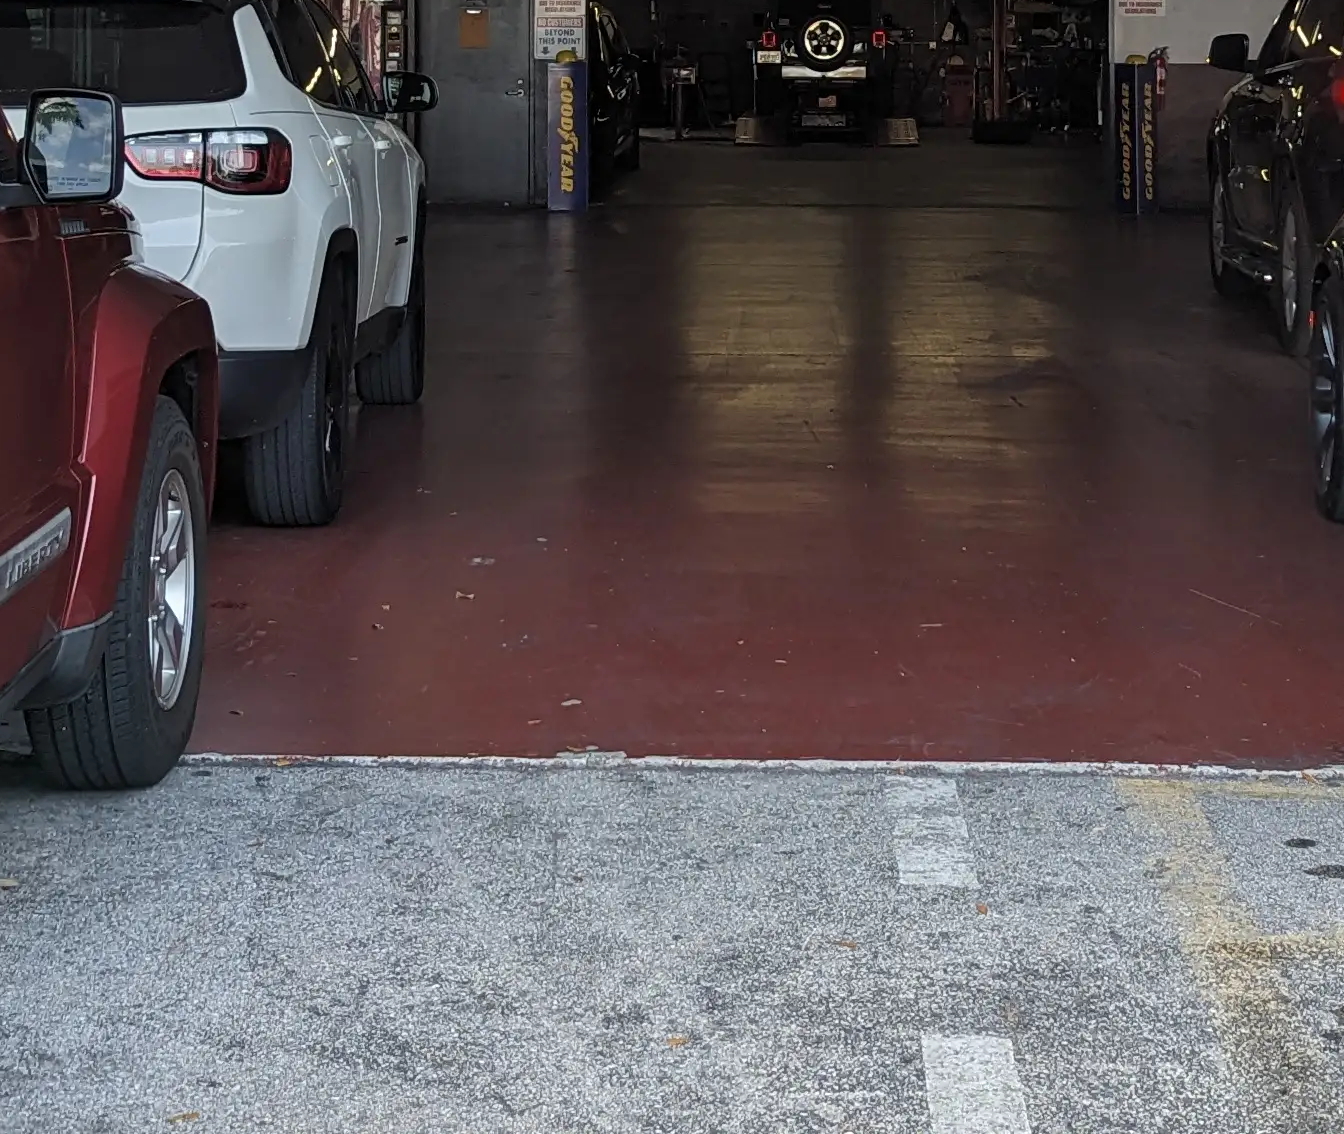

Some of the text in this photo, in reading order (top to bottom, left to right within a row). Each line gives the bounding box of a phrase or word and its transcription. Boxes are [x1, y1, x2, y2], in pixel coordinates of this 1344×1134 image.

[538, 18, 582, 26] NO CUSTOMERS
[539, 37, 581, 45] THIS POINT
[558, 76, 578, 194] GOODYEAR
[1120, 83, 1132, 200] GOODYEAR
[1142, 83, 1154, 200] GOODYEAR
[5, 527, 64, 589] LIBERTY
